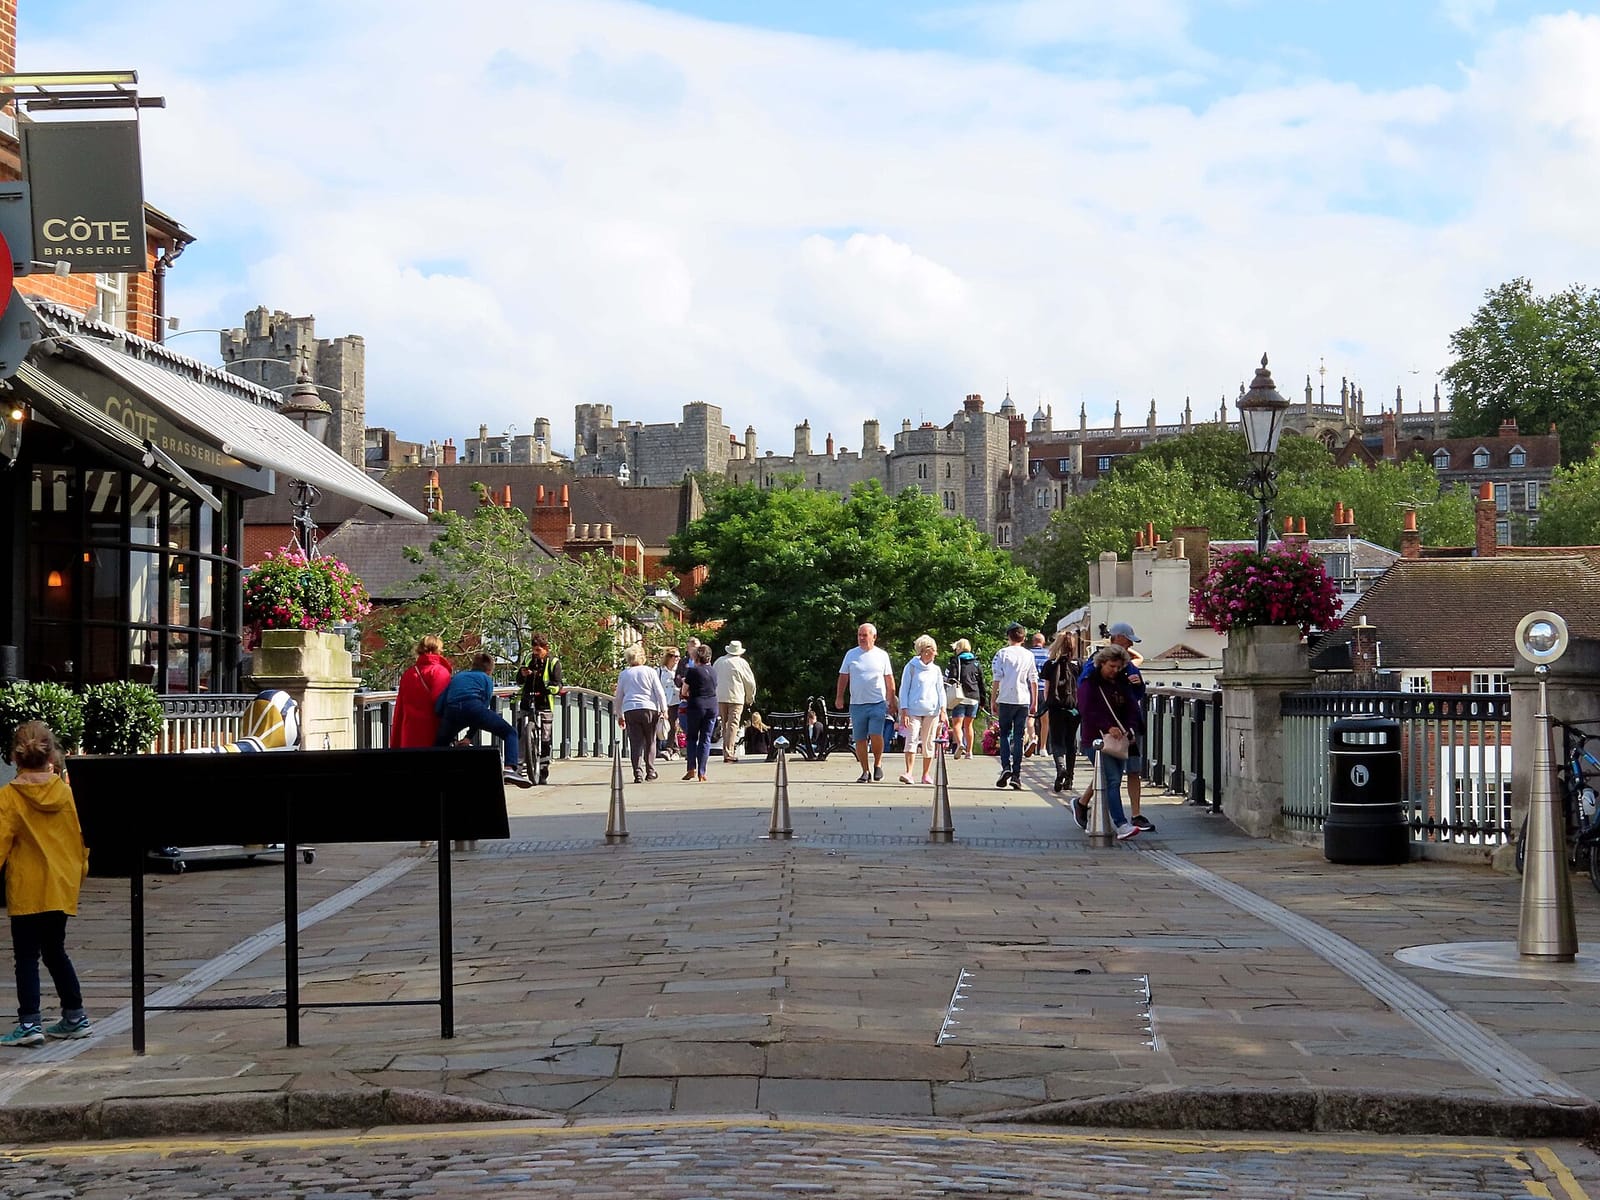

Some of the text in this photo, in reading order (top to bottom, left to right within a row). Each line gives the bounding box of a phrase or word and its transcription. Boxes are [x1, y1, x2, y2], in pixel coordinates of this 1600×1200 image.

[43, 215, 130, 242] CÔTE
[44, 246, 132, 256] BRASSERIE
[162, 436, 222, 466] BRASSERIE
